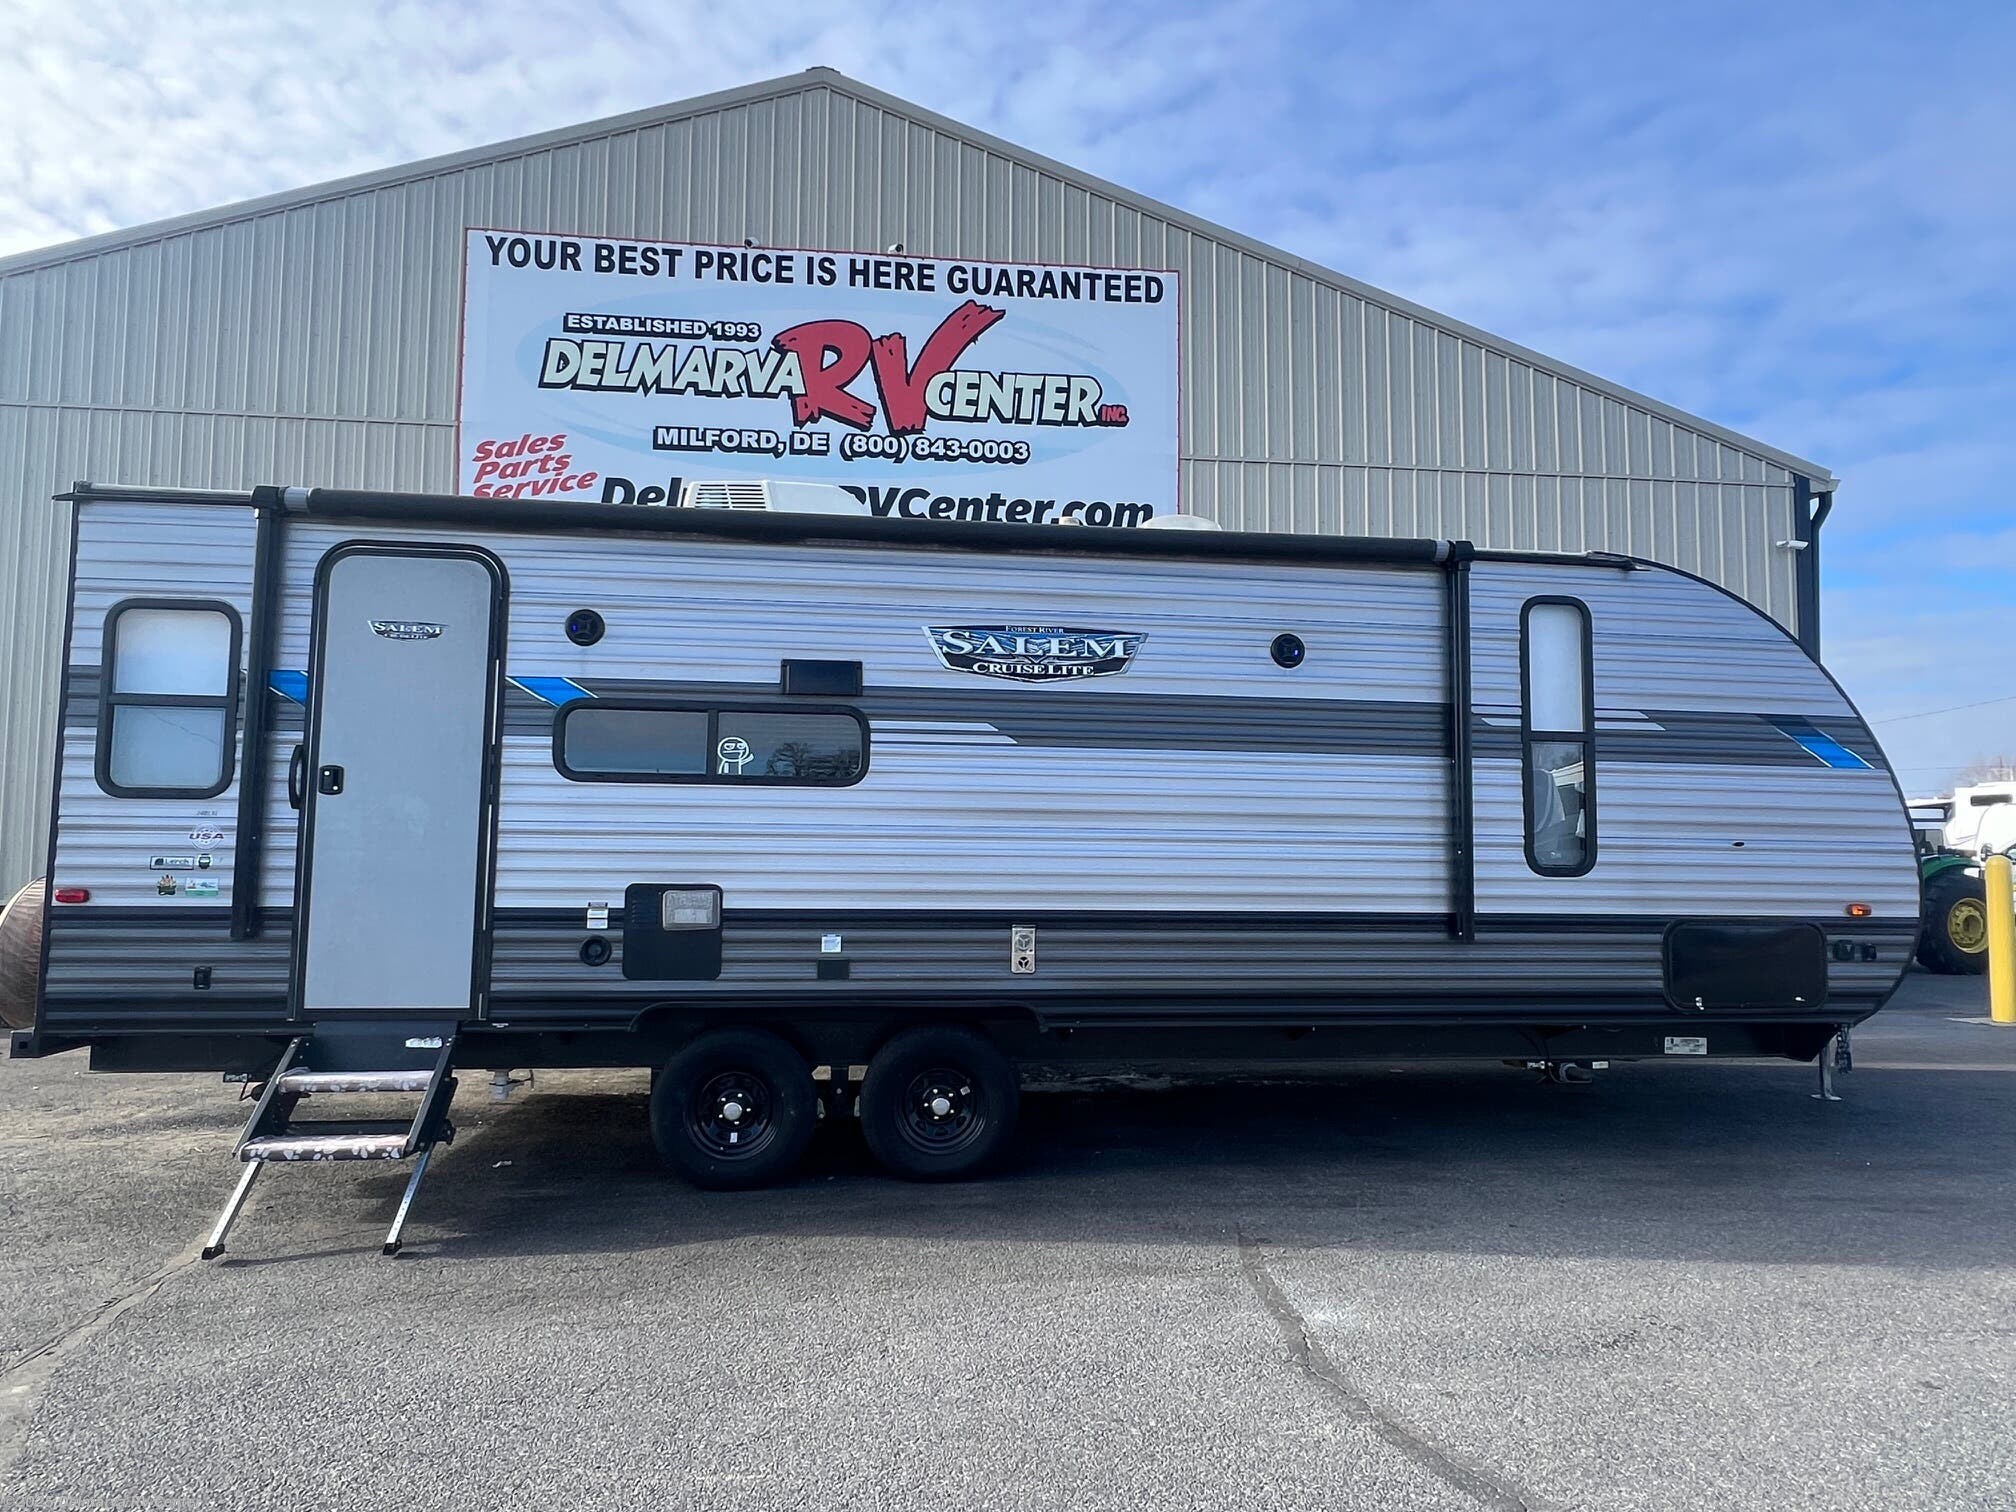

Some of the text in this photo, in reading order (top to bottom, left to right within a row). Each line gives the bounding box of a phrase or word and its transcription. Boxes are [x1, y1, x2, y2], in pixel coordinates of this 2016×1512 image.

[485, 236, 1164, 303] YOUR BEST PRICE IS HERE GUARANTEED
[566, 314, 762, 341] ESTABLISHED 1993
[540, 338, 806, 398] DELMARVA
[771, 300, 1007, 434] RV
[924, 371, 1103, 427] CENTER
[472, 433, 568, 462] Sales
[655, 426, 1031, 463] MILFORD, DE (800) 843-0003
[473, 454, 573, 484] Parts
[473, 472, 598, 499] Service
[374, 622, 441, 634] SALEM
[1005, 625, 1064, 634] FOREST RIVER
[942, 630, 1129, 658] SALEM
[189, 832, 224, 840] USA
